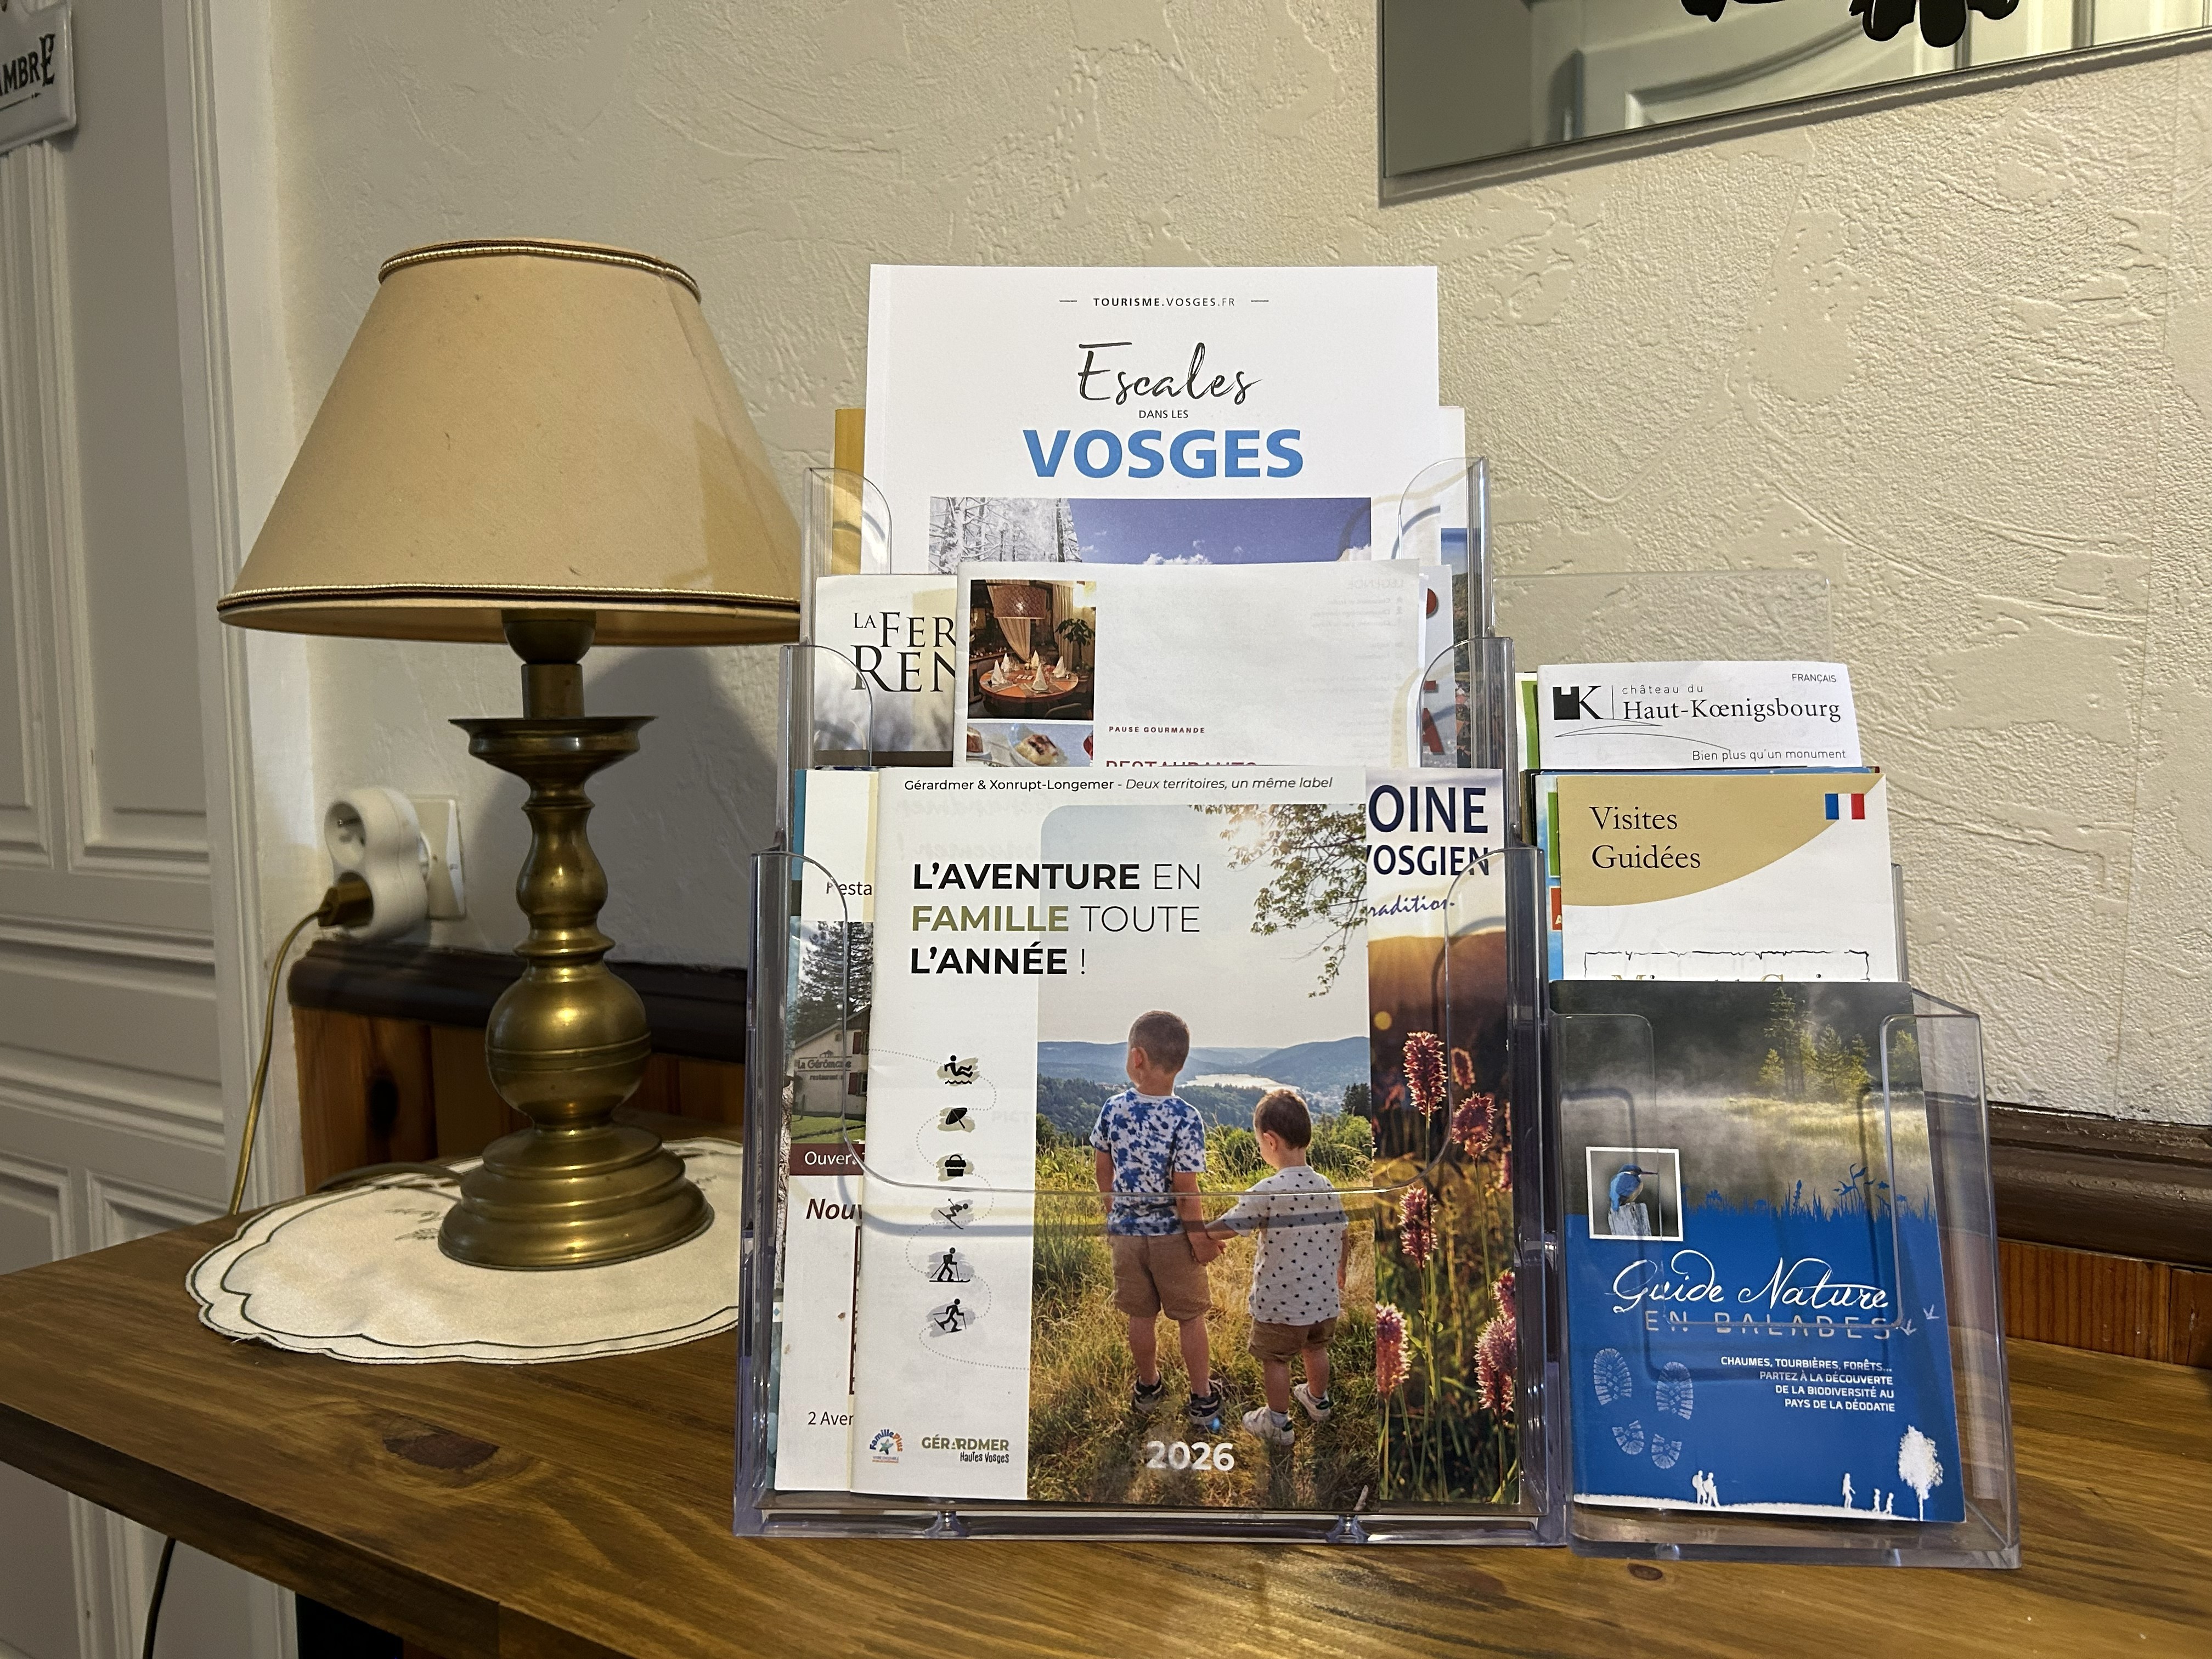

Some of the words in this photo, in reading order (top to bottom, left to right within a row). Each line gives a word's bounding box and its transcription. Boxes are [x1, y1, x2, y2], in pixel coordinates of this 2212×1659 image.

[0, 33, 55, 97] MBRE
[1094, 297, 1235, 307] TOURISME.VOSGES.FR
[1078, 342, 1263, 405] Escales
[1139, 410, 1167, 419] DANS
[1171, 410, 1188, 419] LES
[1023, 429, 1304, 478] VOSGES
[853, 612, 877, 629] LA
[879, 612, 956, 647] FER
[1622, 685, 1680, 695] château
[1688, 685, 1703, 693] du
[1791, 673, 1837, 684] FRANÇAIS
[1623, 698, 1841, 723] Haut-Kœnigsbourg
[1692, 750, 1718, 761] Bien
[1722, 749, 1746, 762] plus
[1750, 749, 1782, 762] qu'un
[1786, 749, 1846, 760] monument
[905, 780, 973, 791] Gérardmer
[978, 781, 986, 790] &
[990, 780, 1114, 792] Xonrupt-Longemer
[1126, 779, 1160, 789] Deux
[1163, 777, 1228, 791] territoires,
[1232, 780, 1248, 788] un
[1252, 777, 1295, 788] même
[1300, 777, 1333, 788] label
[1369, 785, 1488, 833] OINE
[1589, 806, 1678, 830] Visites
[1592, 845, 1701, 869] Guidées
[914, 862, 1139, 889] L'AVENTURE
[1155, 864, 1200, 889] EN
[912, 906, 1069, 931] FAMILLE
[1080, 906, 1200, 932] TOUTE
[911, 941, 1067, 974] L'ANNÉE
[1081, 949, 1086, 974] !
[1604, 1249, 1724, 1314] Guide
[1738, 1257, 1889, 1310] Nature
[1645, 1311, 1688, 1332] EN
[1720, 1357, 1773, 1367] CHAUMES,
[1775, 1357, 1841, 1370] TOURBIÈRES,
[1843, 1359, 1892, 1372] FORÊTS...
[1760, 1372, 1798, 1381] PARTEZ
[1800, 1370, 1808, 1381] À
[1810, 1373, 1823, 1381] LA
[1825, 1372, 1893, 1385] DÉCOUVERTE
[1776, 1385, 1788, 1394] DE
[1791, 1386, 1805, 1395] LA
[1807, 1386, 1877, 1398] BIODIVERSITÉ
[1880, 1390, 1894, 1398] AU
[1785, 1399, 1810, 1408] PAYS
[1813, 1400, 1826, 1408] DE
[1829, 1401, 1843, 1409] LA
[1846, 1399, 1895, 1412] DÉODATIE
[808, 1412, 816, 1425] 2
[1147, 1441, 1234, 1471] 2026
